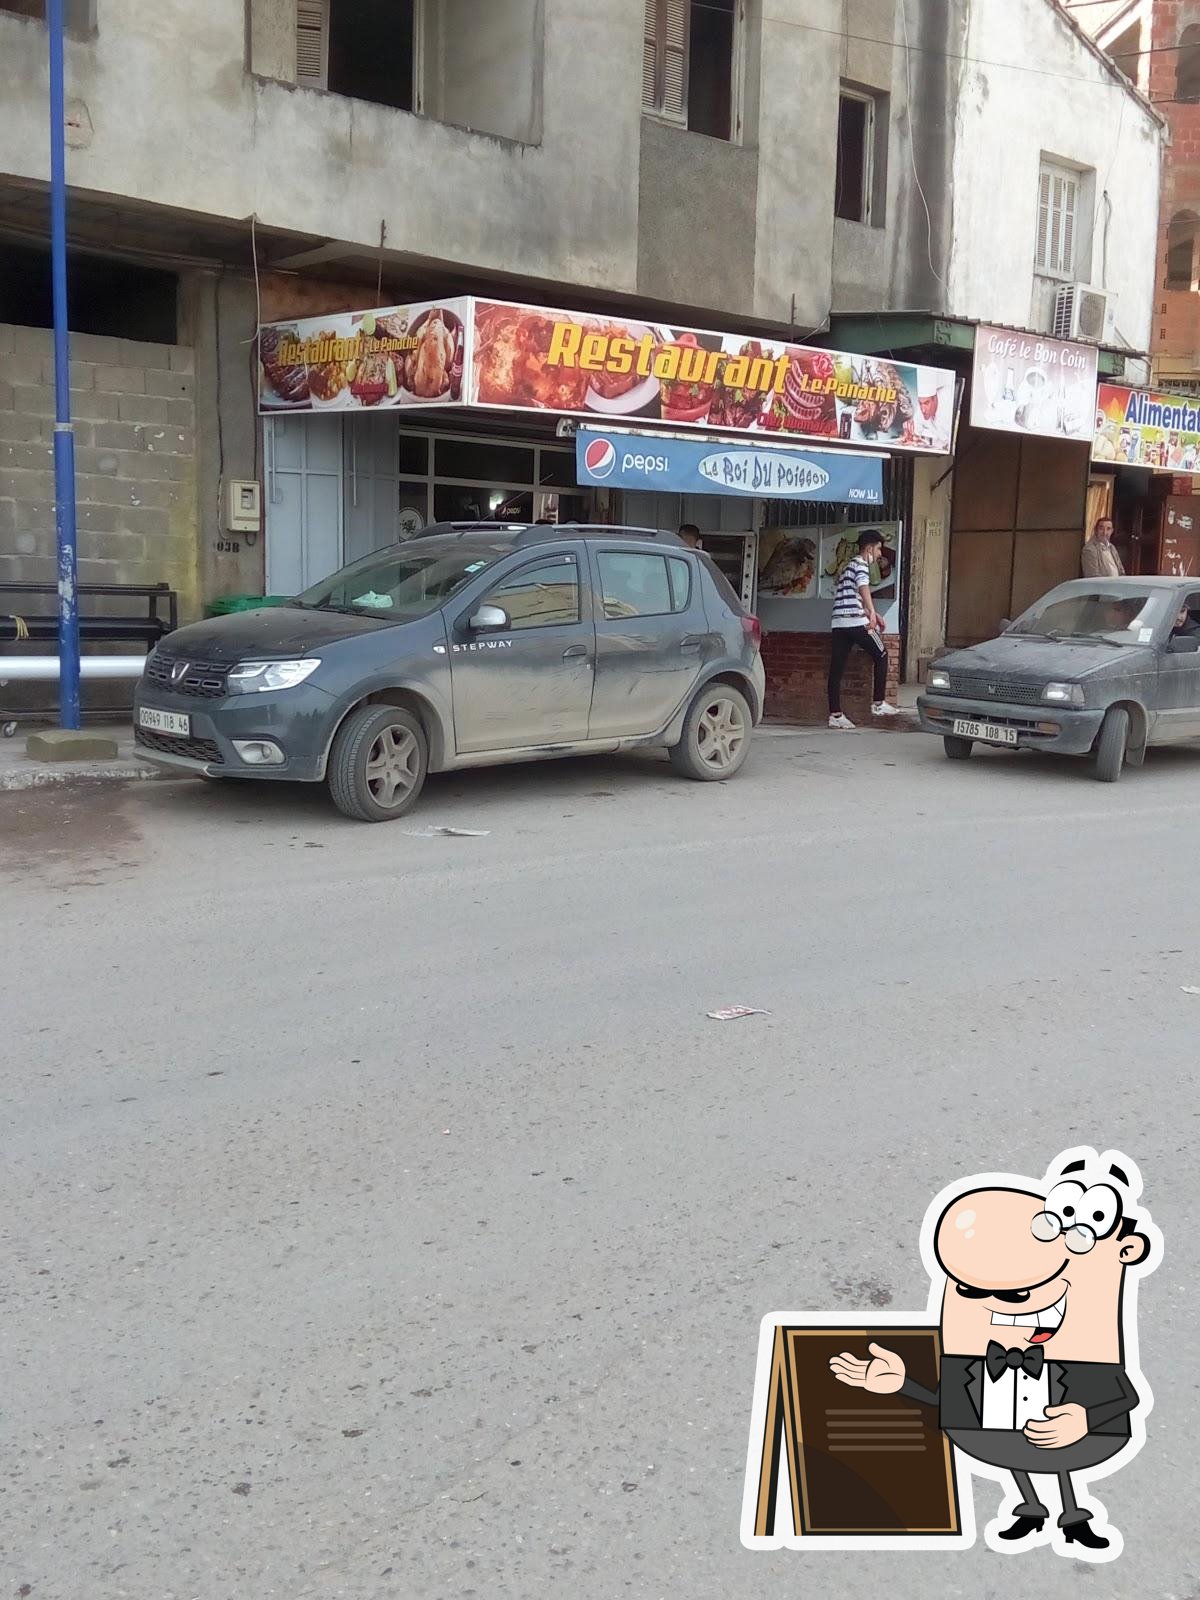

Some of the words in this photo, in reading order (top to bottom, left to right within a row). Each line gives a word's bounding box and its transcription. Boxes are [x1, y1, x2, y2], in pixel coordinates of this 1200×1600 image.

[278, 335, 364, 366] Restaurant
[547, 321, 792, 394] Restaurant
[801, 374, 823, 393] Le
[988, 335, 1017, 358] Café
[1019, 341, 1031, 360] le
[1034, 343, 1057, 363] Bon
[1060, 348, 1086, 369] Coin
[621, 453, 669, 475] pepsi
[846, 488, 865, 499] NOW
[452, 640, 513, 652] STEPWAY
[956, 720, 980, 736] 15785
[985, 725, 999, 739] 108
[1004, 729, 1015, 742] 15
